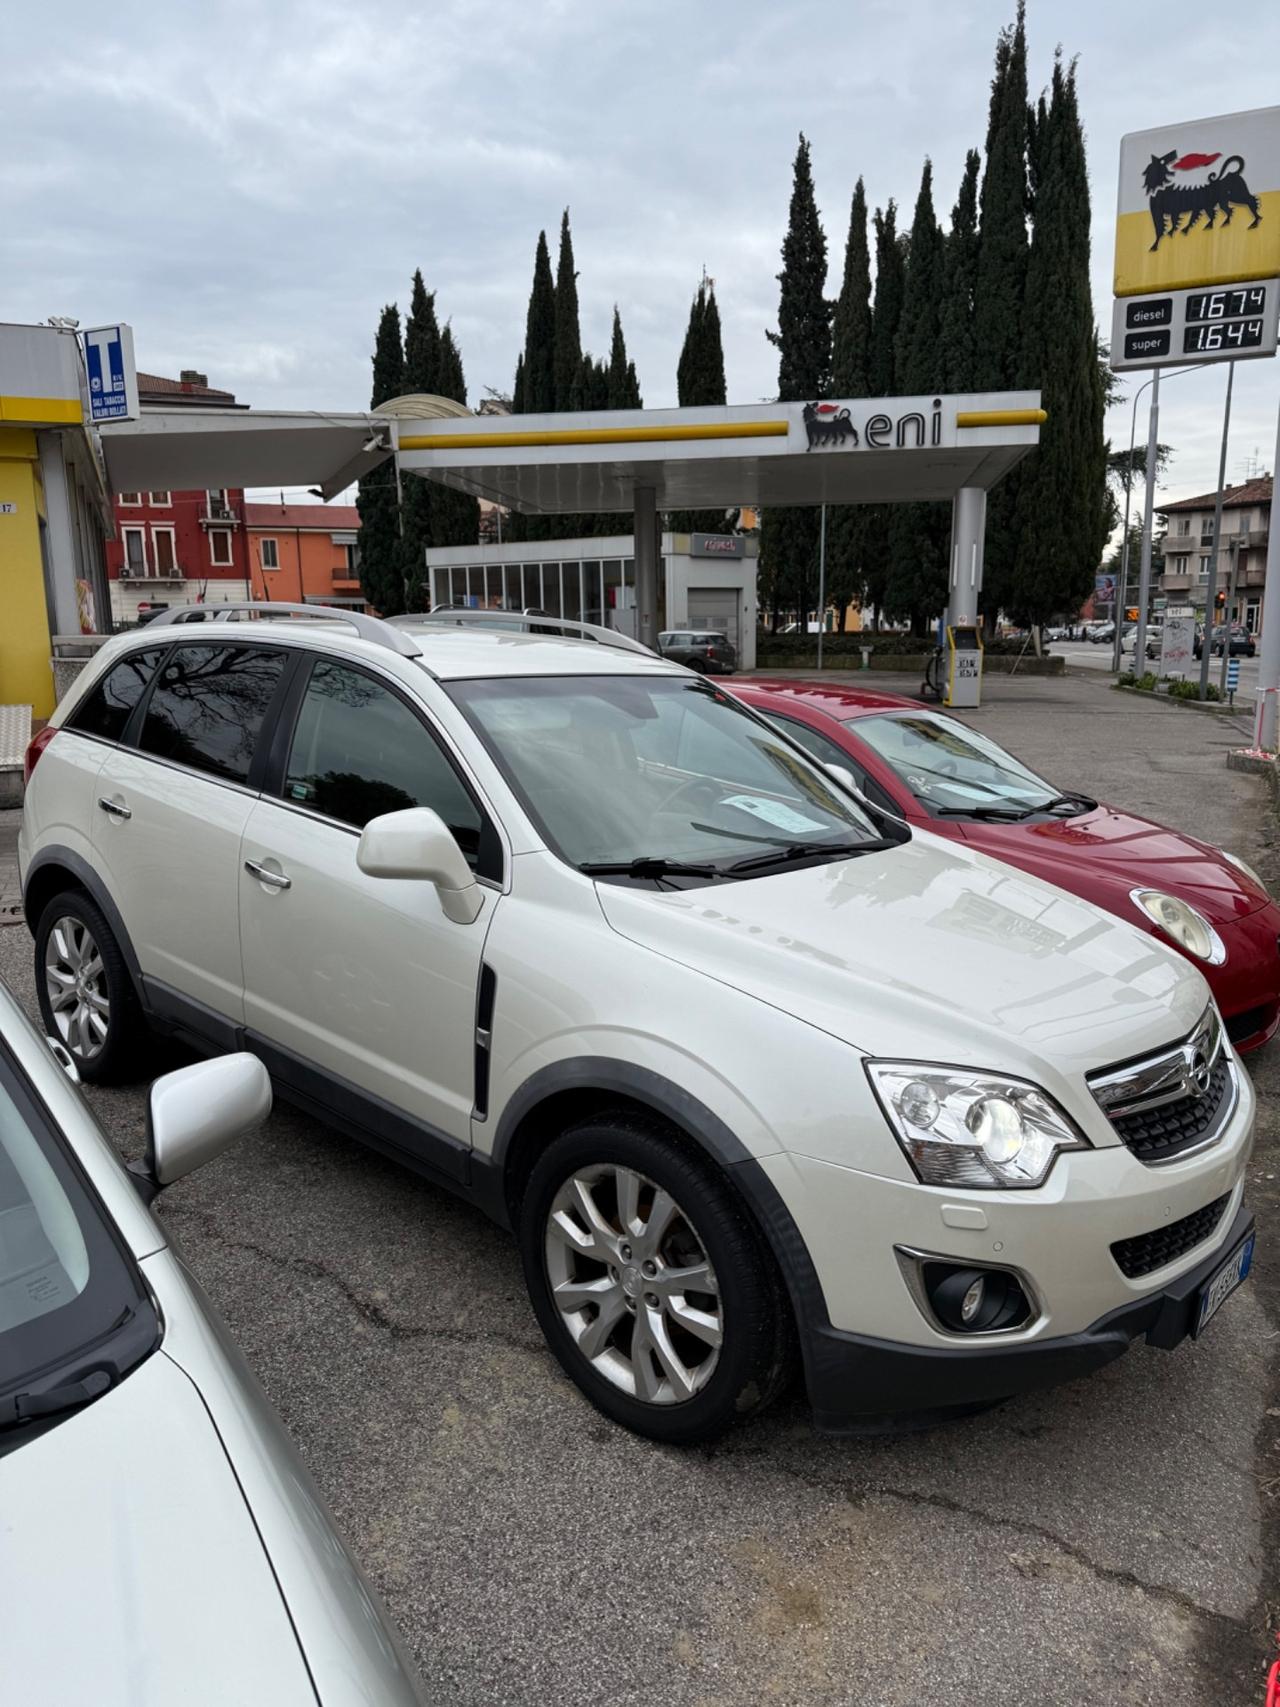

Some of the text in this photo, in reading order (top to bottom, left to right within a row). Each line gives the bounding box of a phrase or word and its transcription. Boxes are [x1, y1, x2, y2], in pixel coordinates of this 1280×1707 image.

[1133, 308, 1165, 322] diesel
[87, 328, 119, 393] T
[1131, 339, 1162, 351] super
[865, 398, 942, 448] eni
